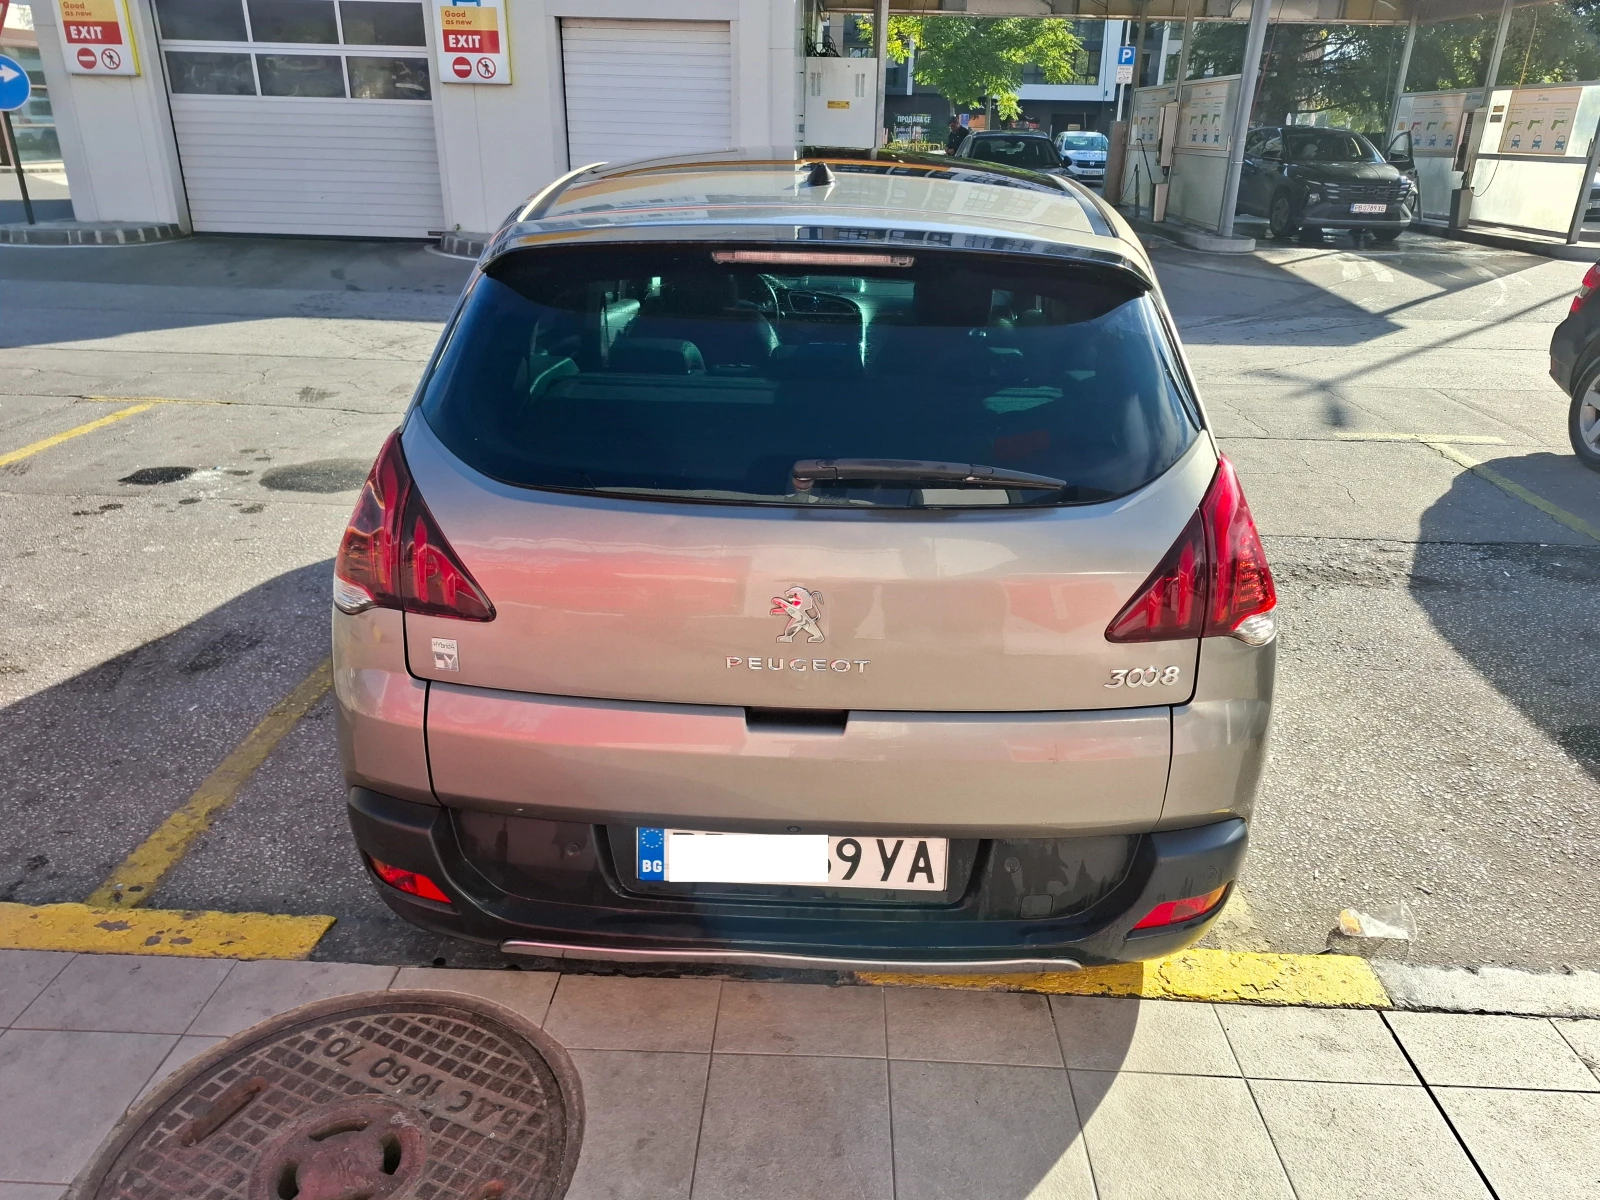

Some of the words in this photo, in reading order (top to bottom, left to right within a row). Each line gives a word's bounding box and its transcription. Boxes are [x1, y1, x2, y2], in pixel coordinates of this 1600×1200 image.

[63, 1, 85, 9] Good
[444, 10, 466, 18] Good
[69, 25, 103, 40] EXIT
[448, 34, 481, 48] EXIT
[1121, 48, 1132, 63] P
[725, 655, 871, 674] PEUGEOT
[1103, 665, 1180, 689] 3008
[641, 859, 662, 873] BG
